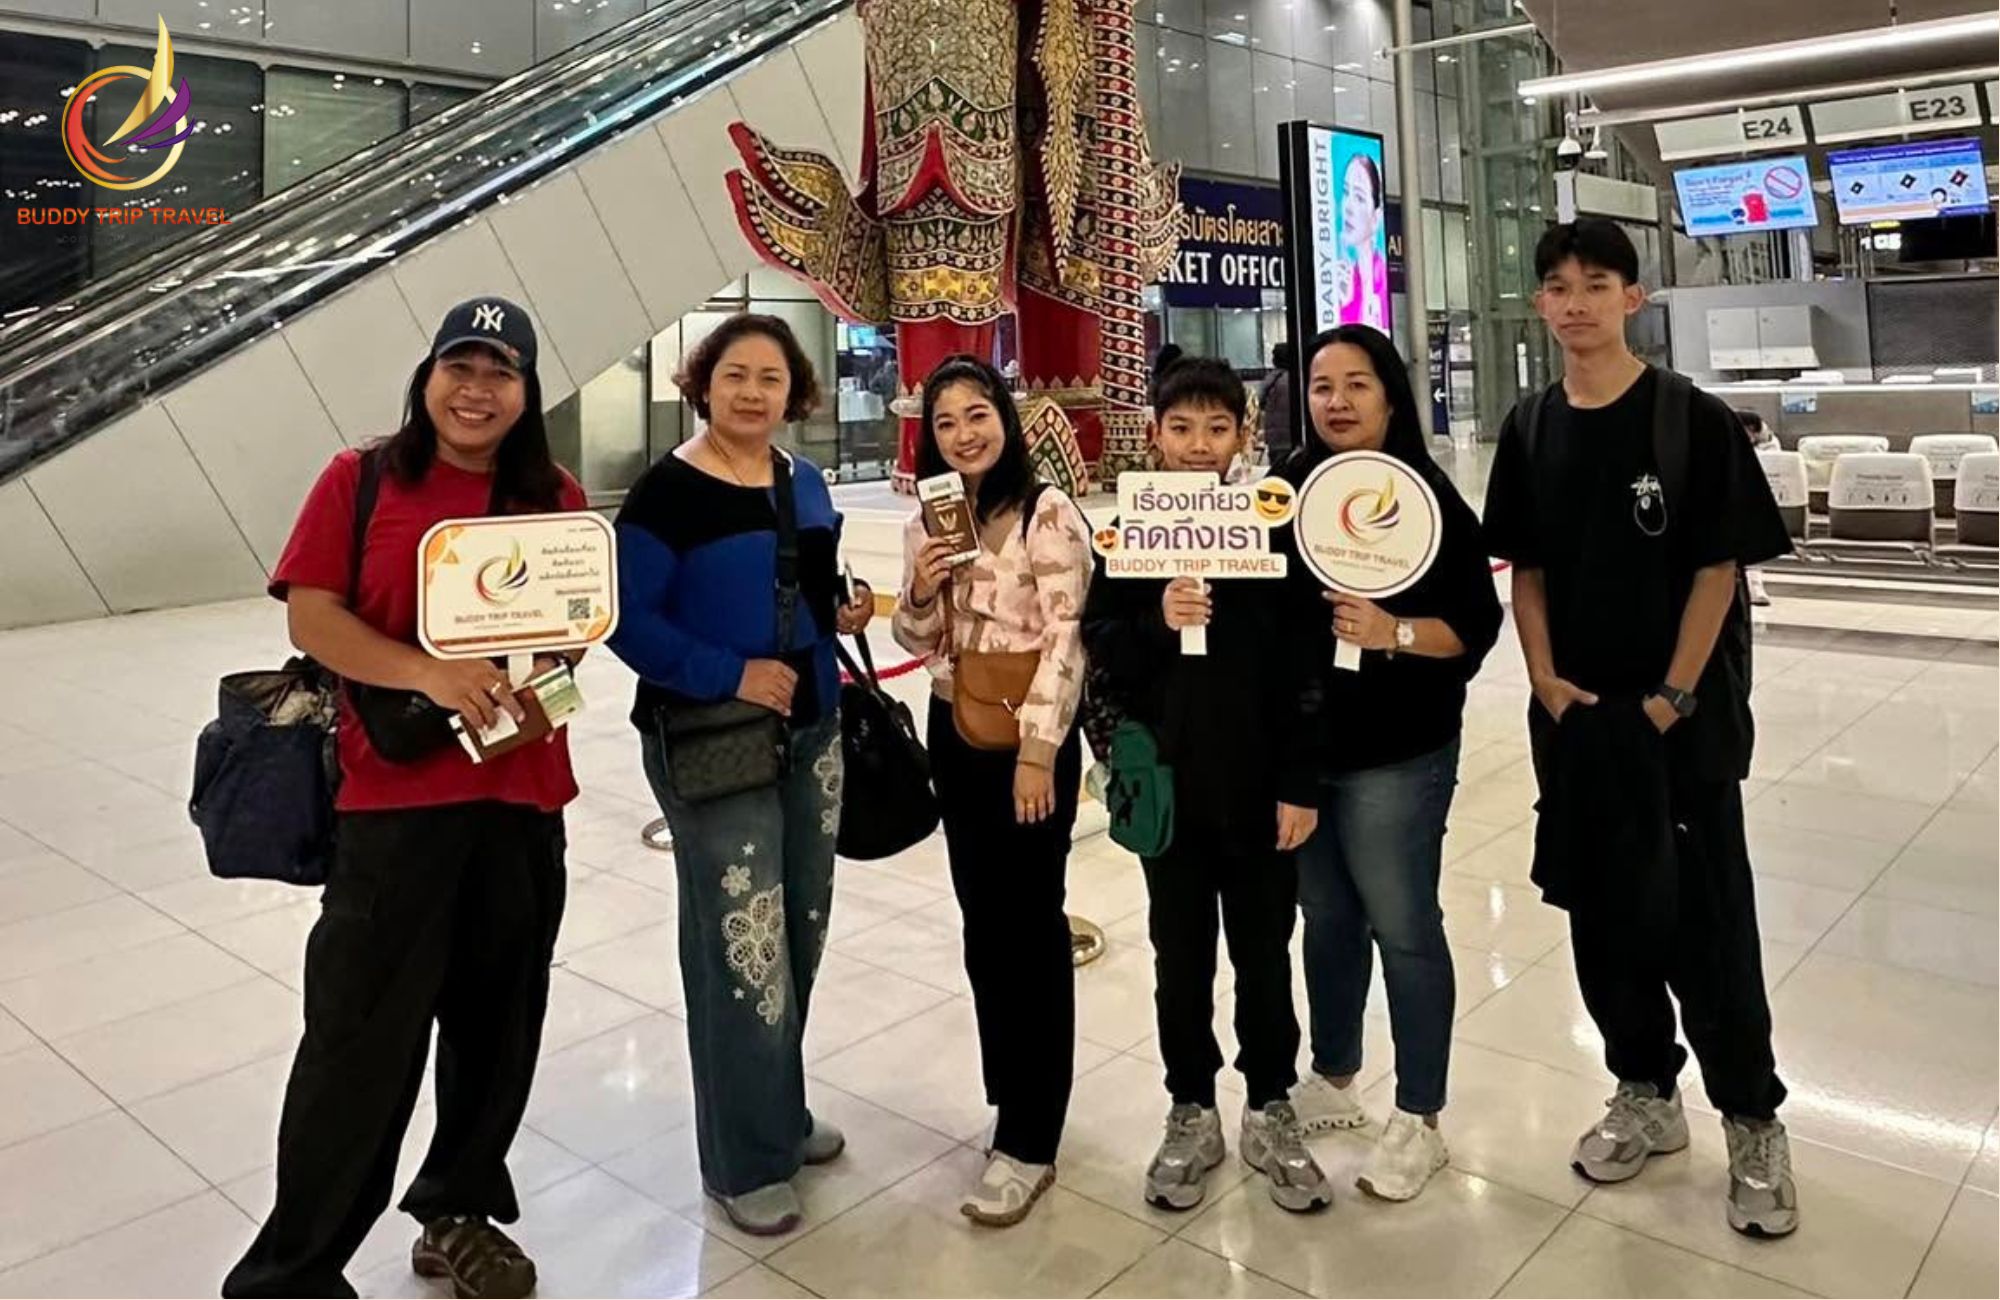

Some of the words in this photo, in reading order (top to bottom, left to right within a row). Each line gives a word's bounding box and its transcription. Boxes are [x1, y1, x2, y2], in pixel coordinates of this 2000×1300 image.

[1909, 95, 1967, 121] E23
[1742, 117, 1793, 141] E24
[1315, 139, 1332, 242] BRIGHT
[1319, 253, 1335, 324] BABY
[1132, 481, 1251, 512] เรื่องเที่ยว
[1123, 516, 1262, 551] คิดถึงเรา
[1109, 558, 1166, 573] BUDDY
[1174, 558, 1212, 573] TRIP
[1219, 558, 1280, 573] TRAVEL
[1349, 550, 1371, 561] TRIP
[1374, 553, 1410, 569] TRAVEL
